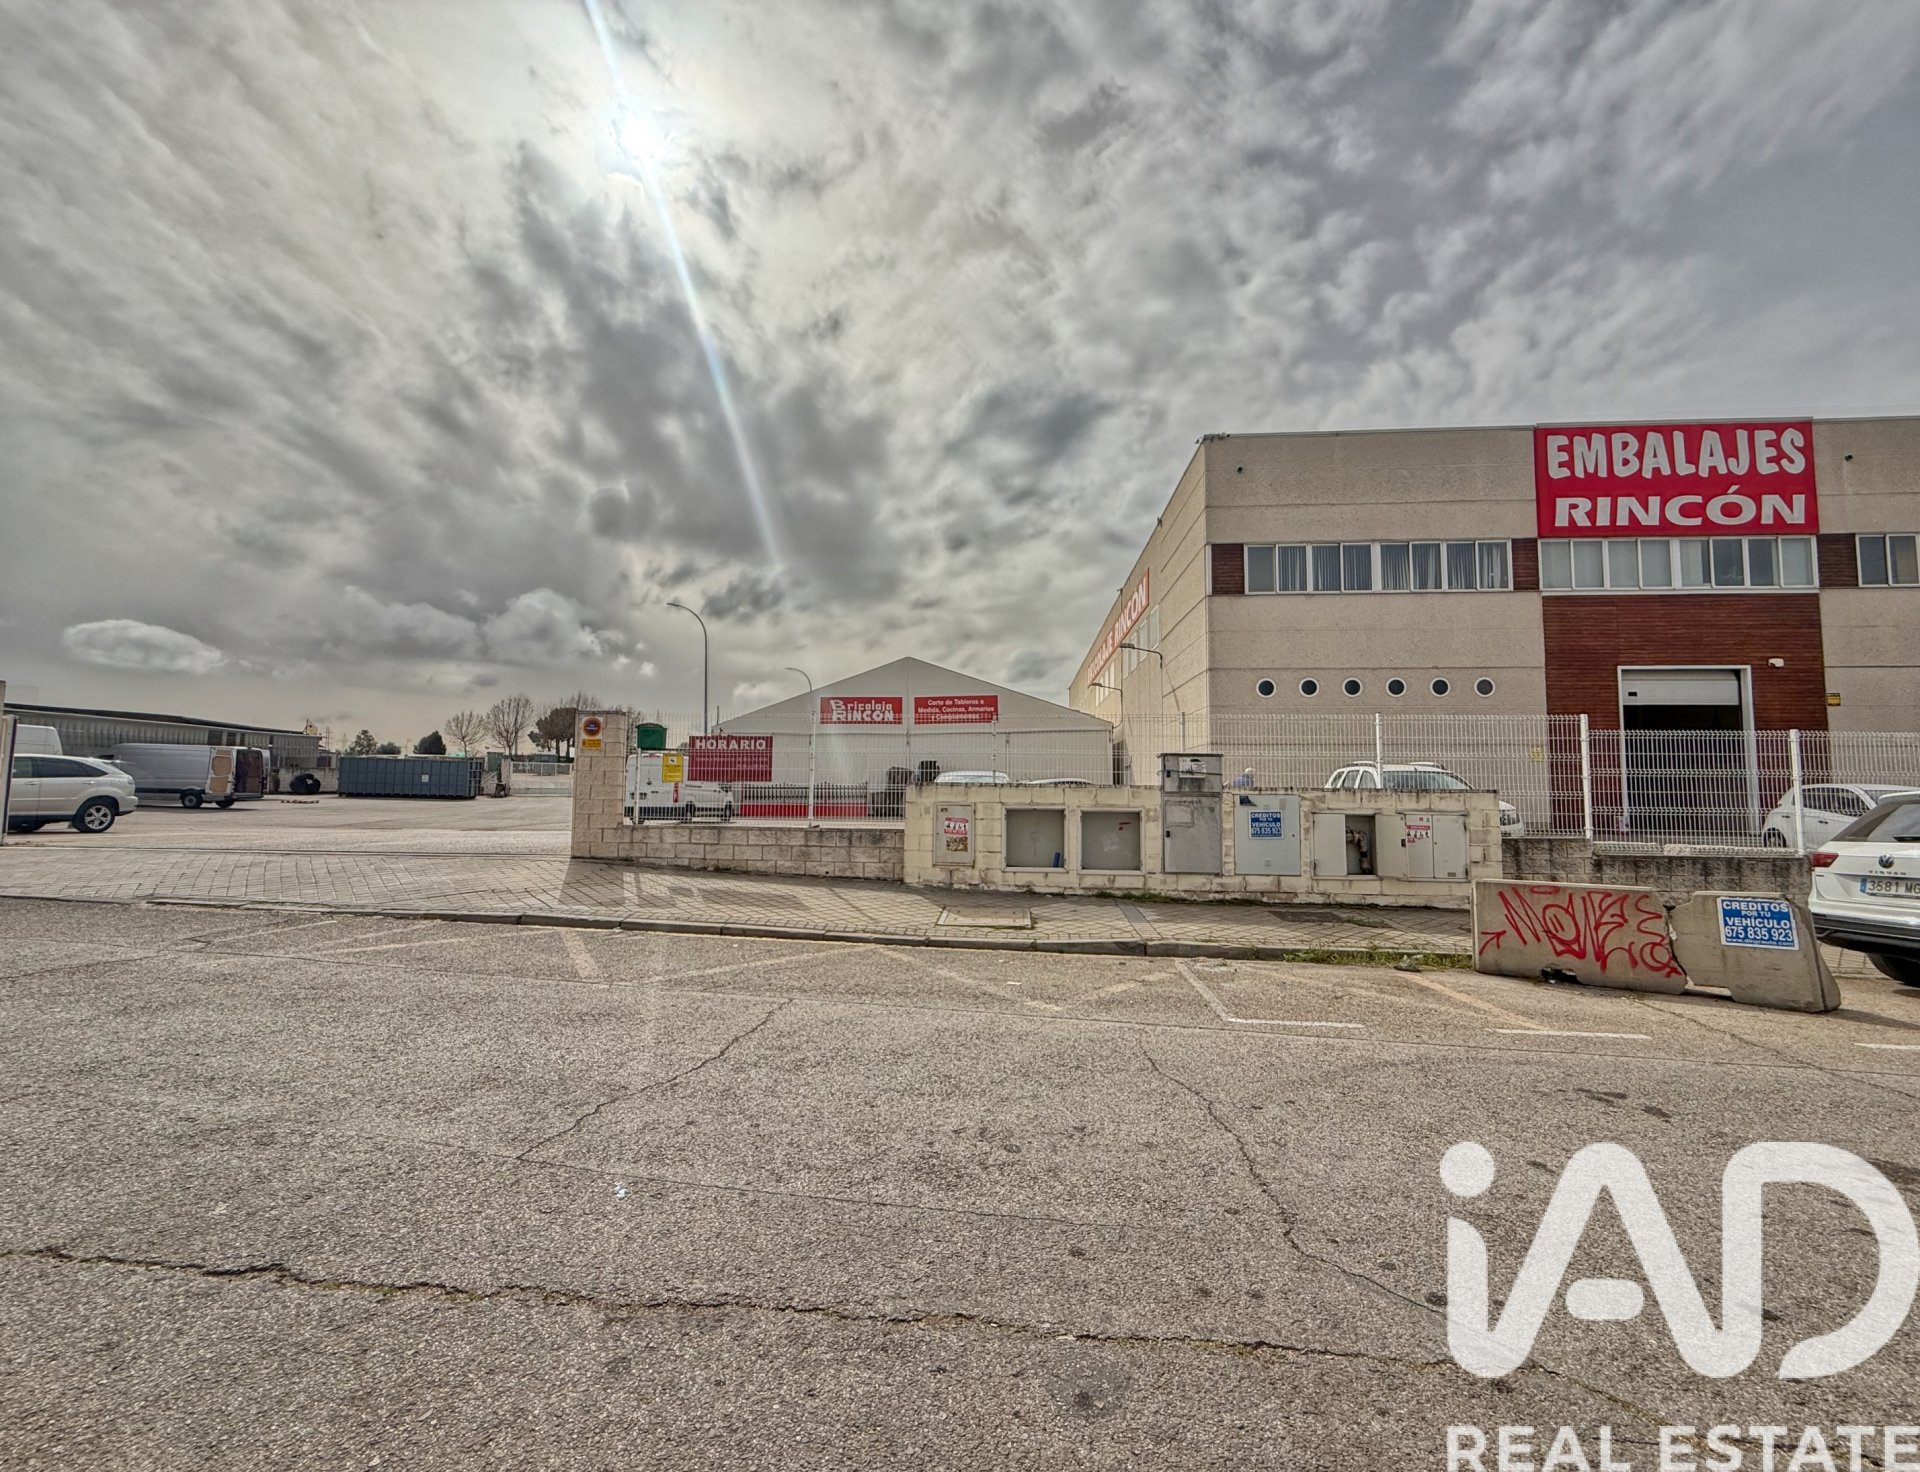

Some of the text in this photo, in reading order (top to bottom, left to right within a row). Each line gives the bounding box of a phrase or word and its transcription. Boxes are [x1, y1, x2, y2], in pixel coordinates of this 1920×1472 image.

[1546, 427, 1806, 480] EMBALAJES
[1554, 484, 1806, 528] RINCÓN
[695, 739, 766, 749] HORARIO
[1868, 880, 1900, 893] 3581
[1722, 901, 1789, 913] CREDITOS
[1725, 915, 1791, 929] VEHÍCULO
[1724, 925, 1793, 942] 675 835 923
